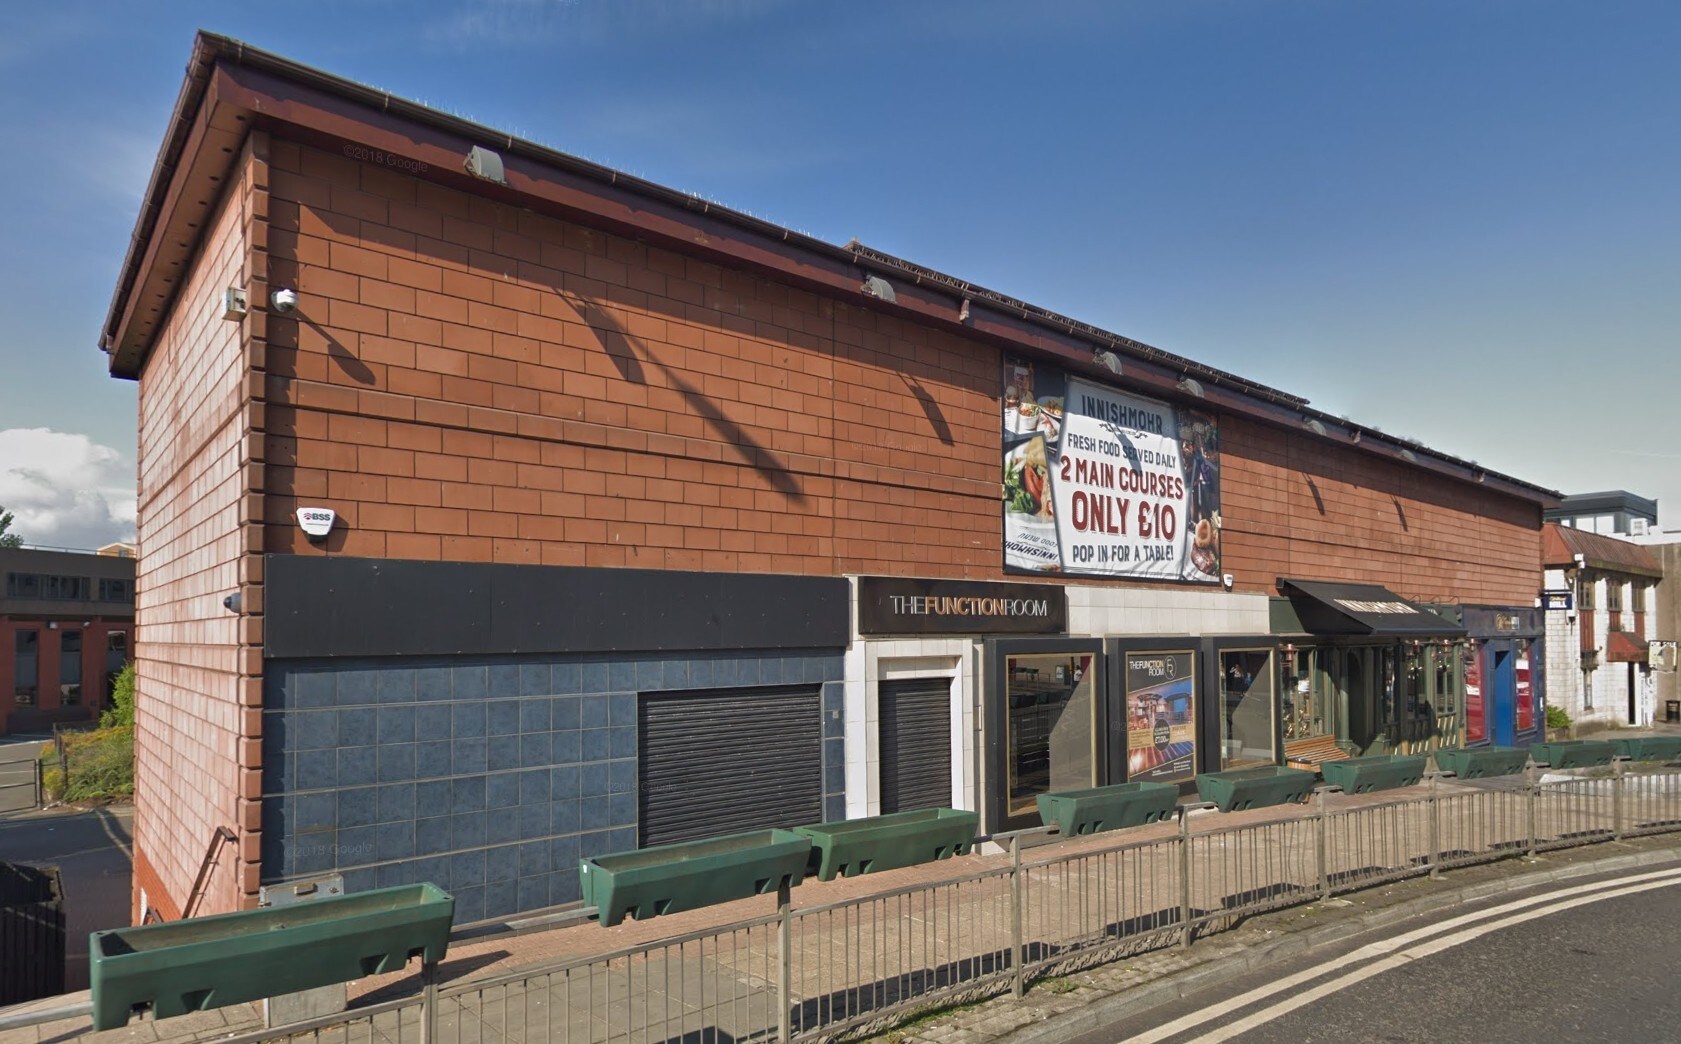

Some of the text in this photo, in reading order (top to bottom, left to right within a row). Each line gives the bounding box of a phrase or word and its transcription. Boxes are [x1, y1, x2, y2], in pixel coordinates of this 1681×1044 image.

[1081, 394, 1163, 434] INNISHMOHR
[1067, 432, 1176, 469] FRESH FOOD SERVED DAILY
[1060, 455, 1184, 500] 2 MAIN COURSES
[1071, 490, 1177, 542] ONLY £10
[1072, 545, 1174, 563] POP IN FOR A TABLE!
